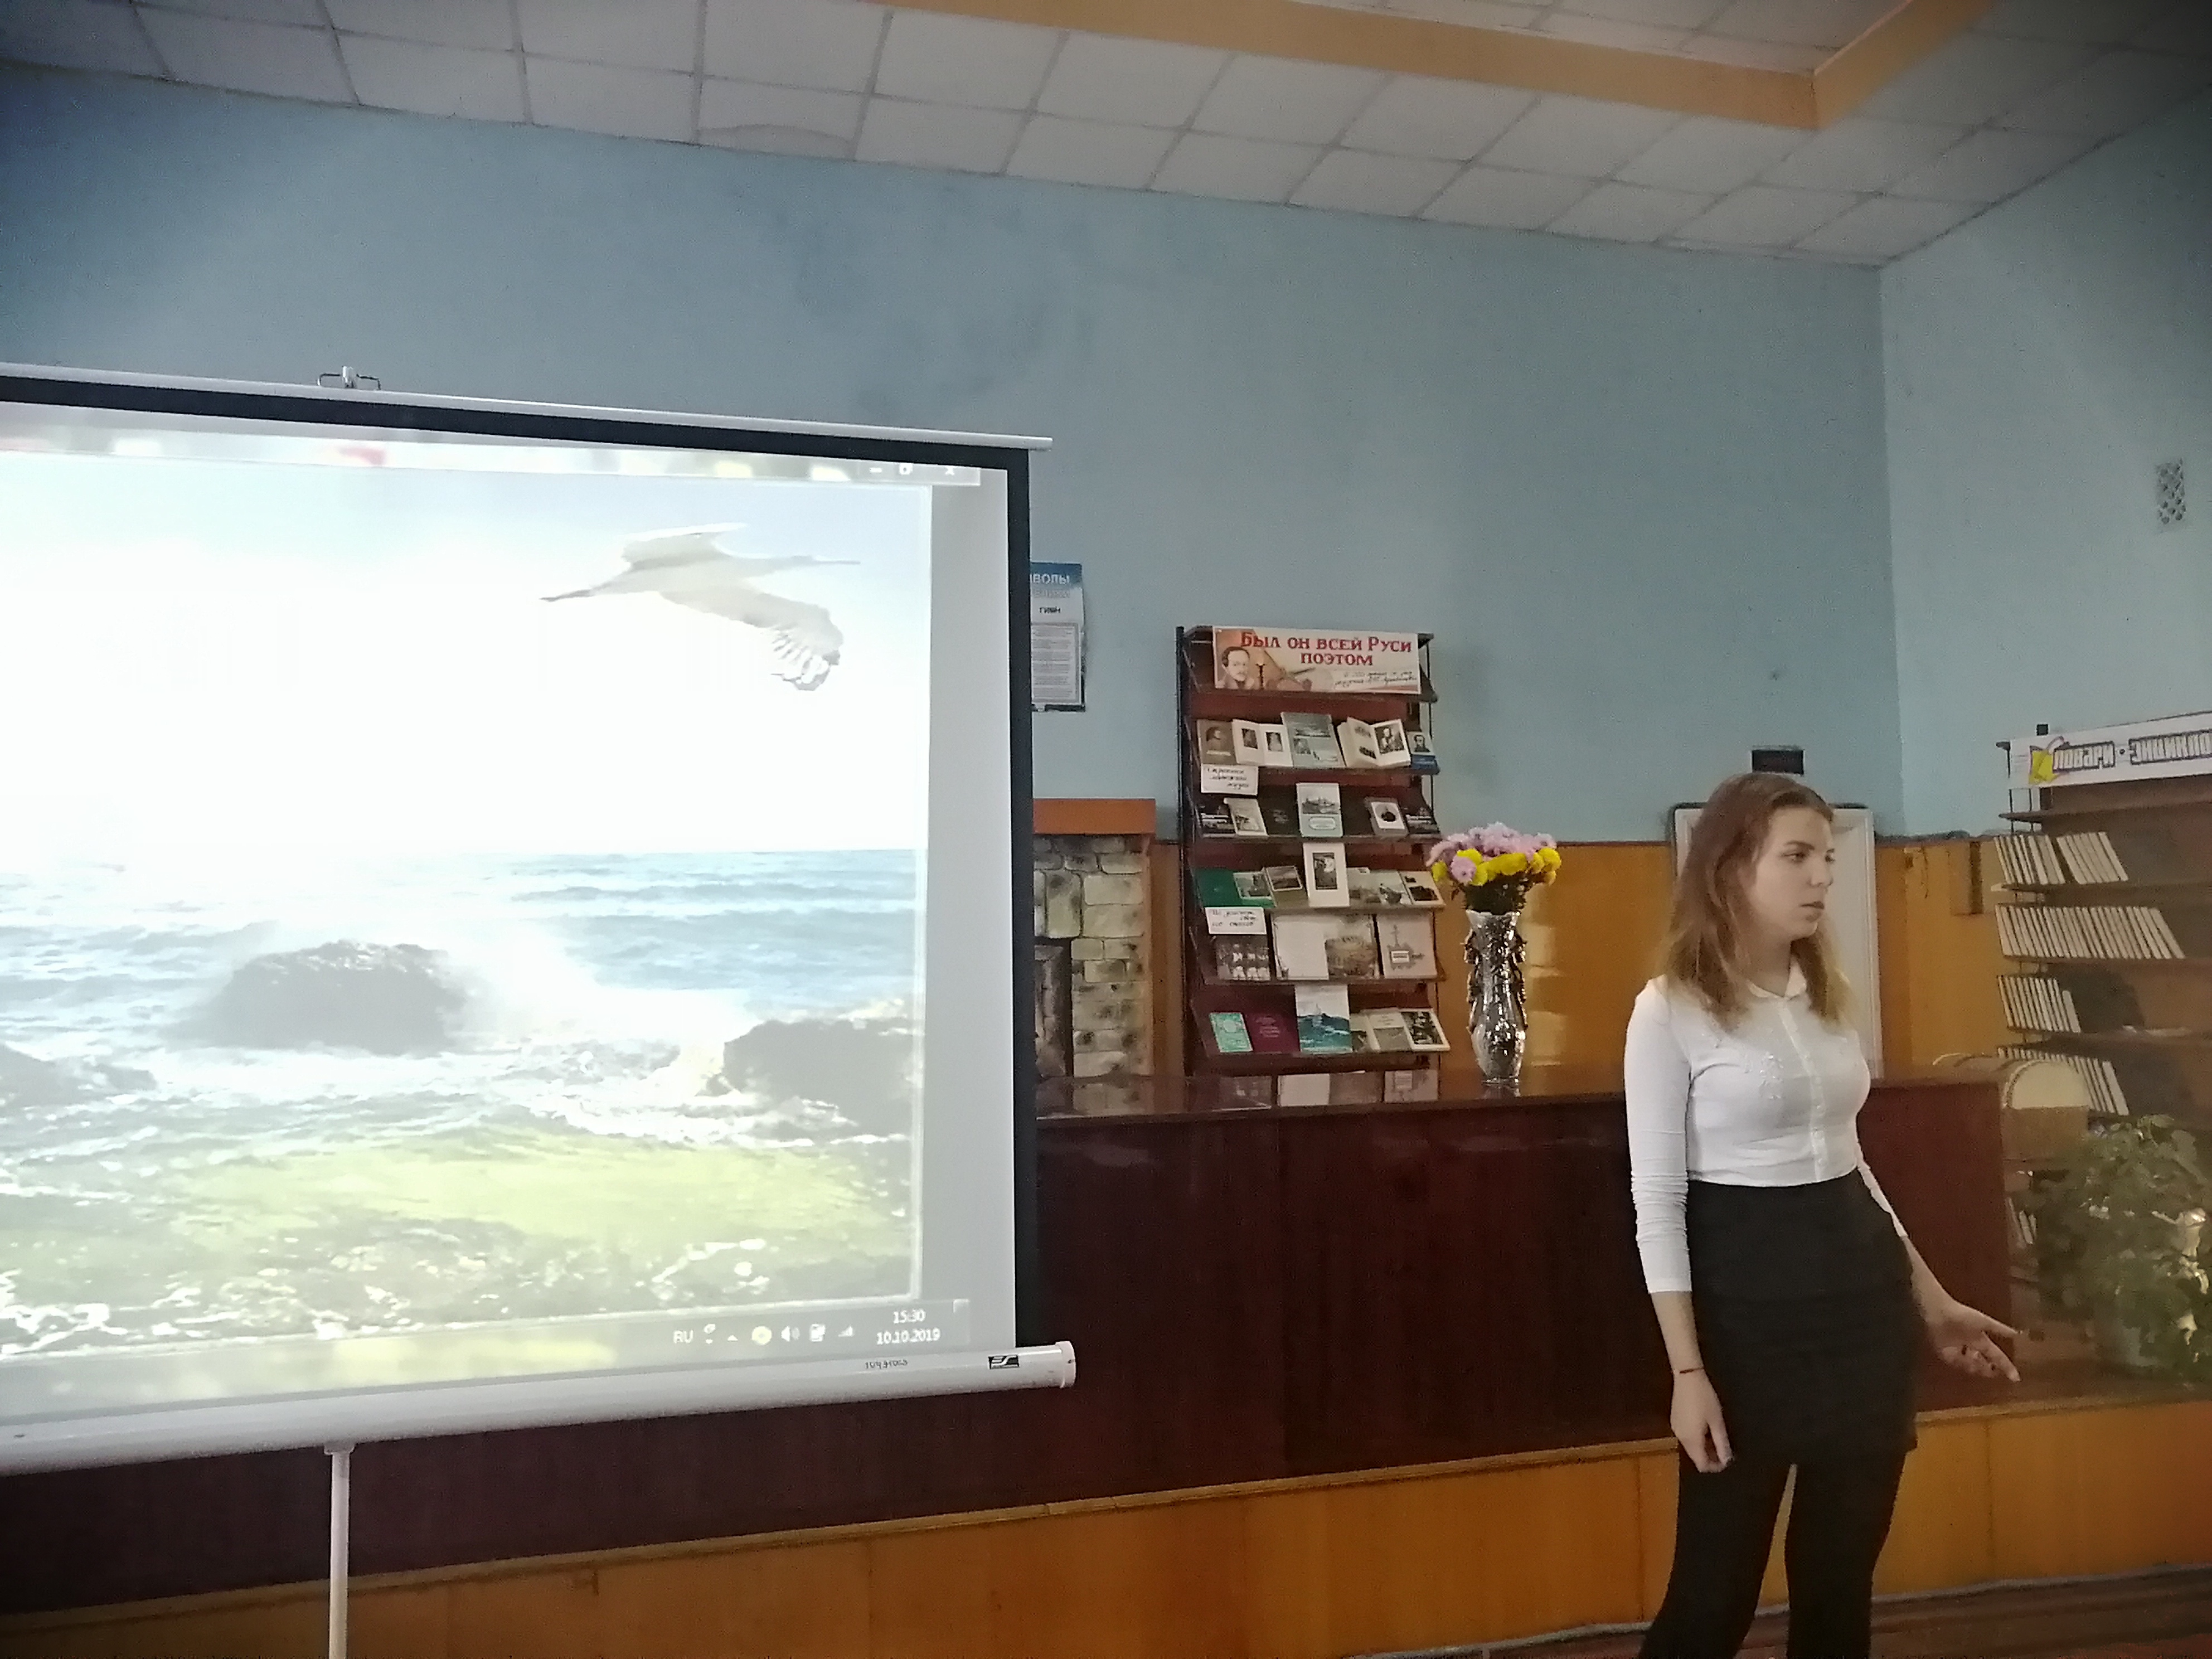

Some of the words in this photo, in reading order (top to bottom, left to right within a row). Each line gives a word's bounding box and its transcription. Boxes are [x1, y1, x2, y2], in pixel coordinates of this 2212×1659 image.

[1287, 637, 1311, 649] ОН
[1316, 637, 1362, 651] ВСЕЙ
[1301, 653, 1373, 666] ПОЭТОМ
[892, 1309, 926, 1324] 15:30
[673, 1329, 694, 1344] RU
[876, 1327, 941, 1345] 10.10.2019
